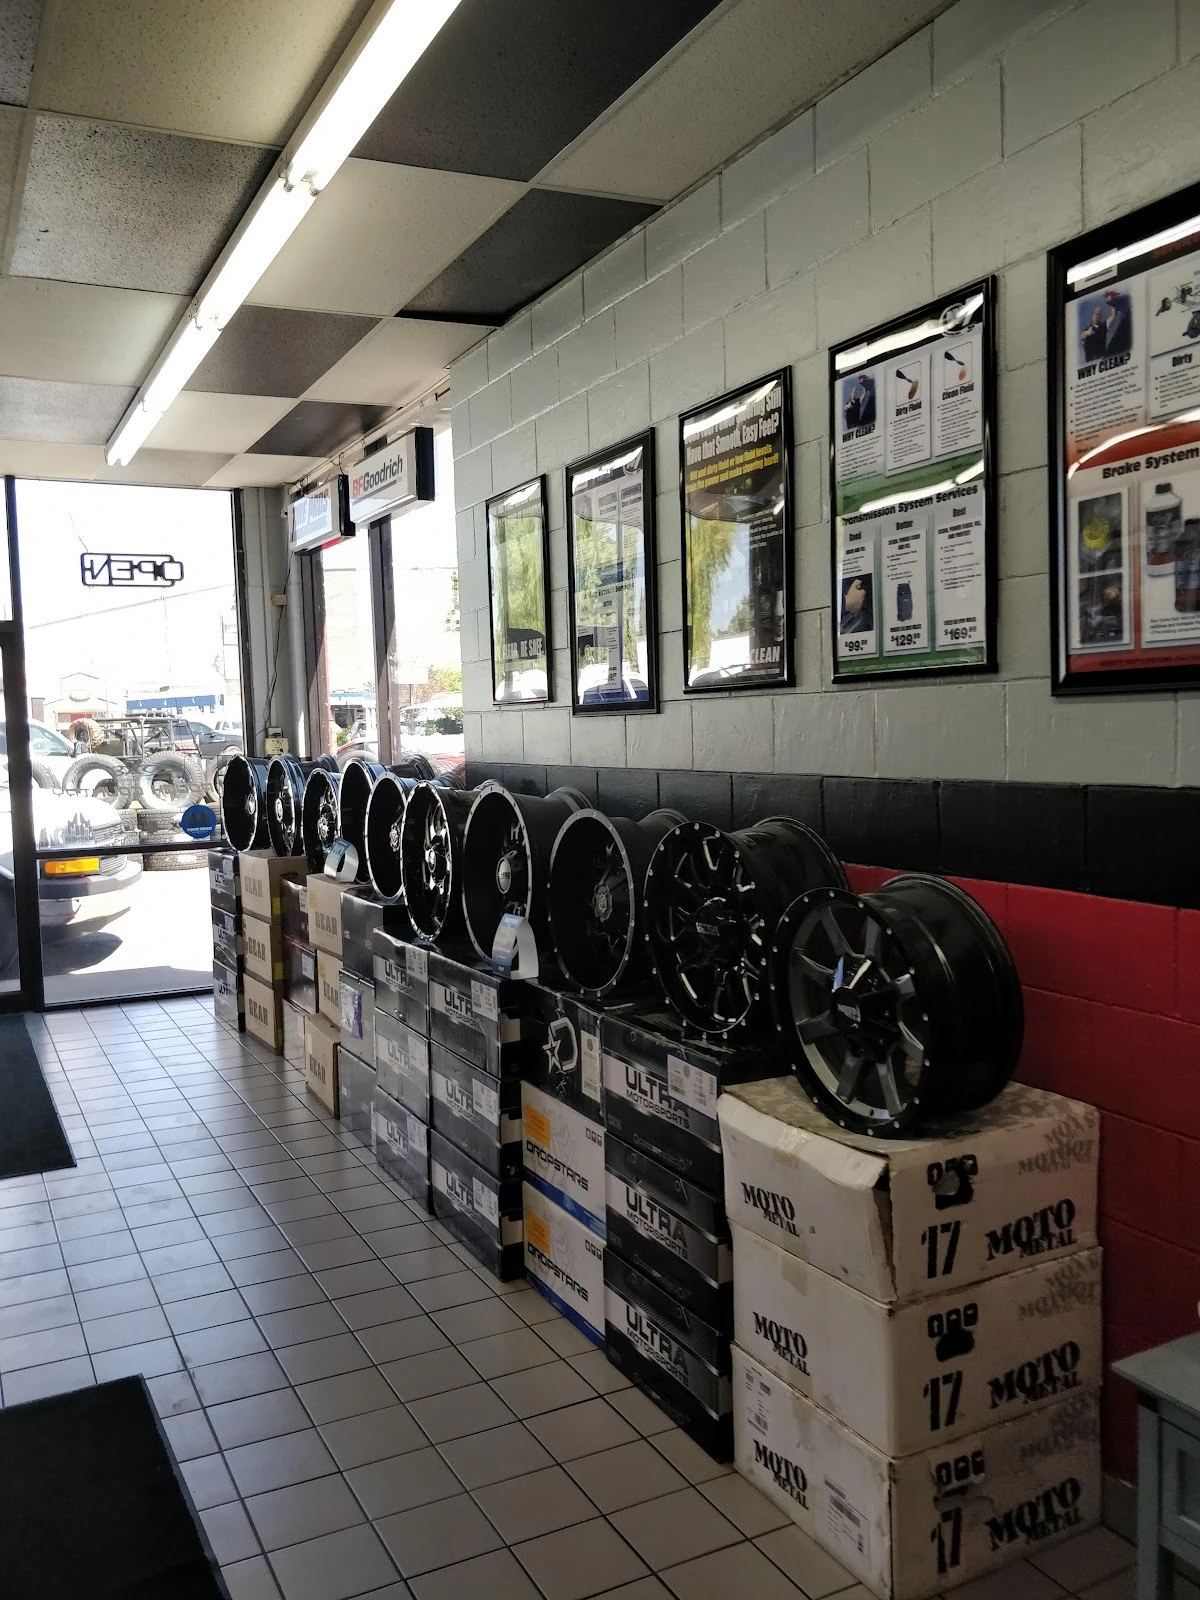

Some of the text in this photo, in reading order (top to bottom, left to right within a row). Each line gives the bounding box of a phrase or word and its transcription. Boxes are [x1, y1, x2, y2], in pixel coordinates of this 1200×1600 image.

[1077, 352, 1131, 380] WHY CLEAN?
[686, 445, 702, 466] Have
[702, 439, 716, 457] that
[742, 422, 758, 444] Easy
[758, 411, 780, 439] Feel?
[842, 424, 875, 443] WHY CLEAN?
[352, 453, 404, 498] BFGoodrich
[1102, 447, 1200, 479] Brake System
[898, 496, 933, 513] System
[935, 484, 978, 503] Services
[520, 640, 528, 658] BE
[844, 639, 868, 652] $99.99
[891, 632, 921, 646] $129.99
[944, 626, 977, 641] $169.99
[244, 875, 264, 898] GEAR
[314, 911, 338, 936] GEAR
[248, 936, 266, 962] GEAR
[248, 997, 269, 1026] GEAR
[309, 1054, 326, 1085] GEAR
[626, 1089, 690, 1129] MOTORSPORTS
[526, 1139, 589, 1192] DROPSTARS
[626, 1185, 688, 1248] ULTRA
[740, 1181, 796, 1221] MOTO
[627, 1209, 688, 1260] MOTORSPORTS
[763, 1208, 800, 1238] METAL
[984, 1198, 1076, 1261] MOTO
[527, 1241, 589, 1303] DROPSTARS
[626, 1304, 690, 1376] ULTRA
[752, 1311, 808, 1360] MOTO
[627, 1327, 689, 1387] MOTORSPORTS
[772, 1341, 811, 1377] METAL
[987, 1340, 1081, 1409] MOTO
[752, 1438, 808, 1493] MOTO
[773, 1469, 810, 1511] METAL
[984, 1476, 1081, 1552] MOTO
